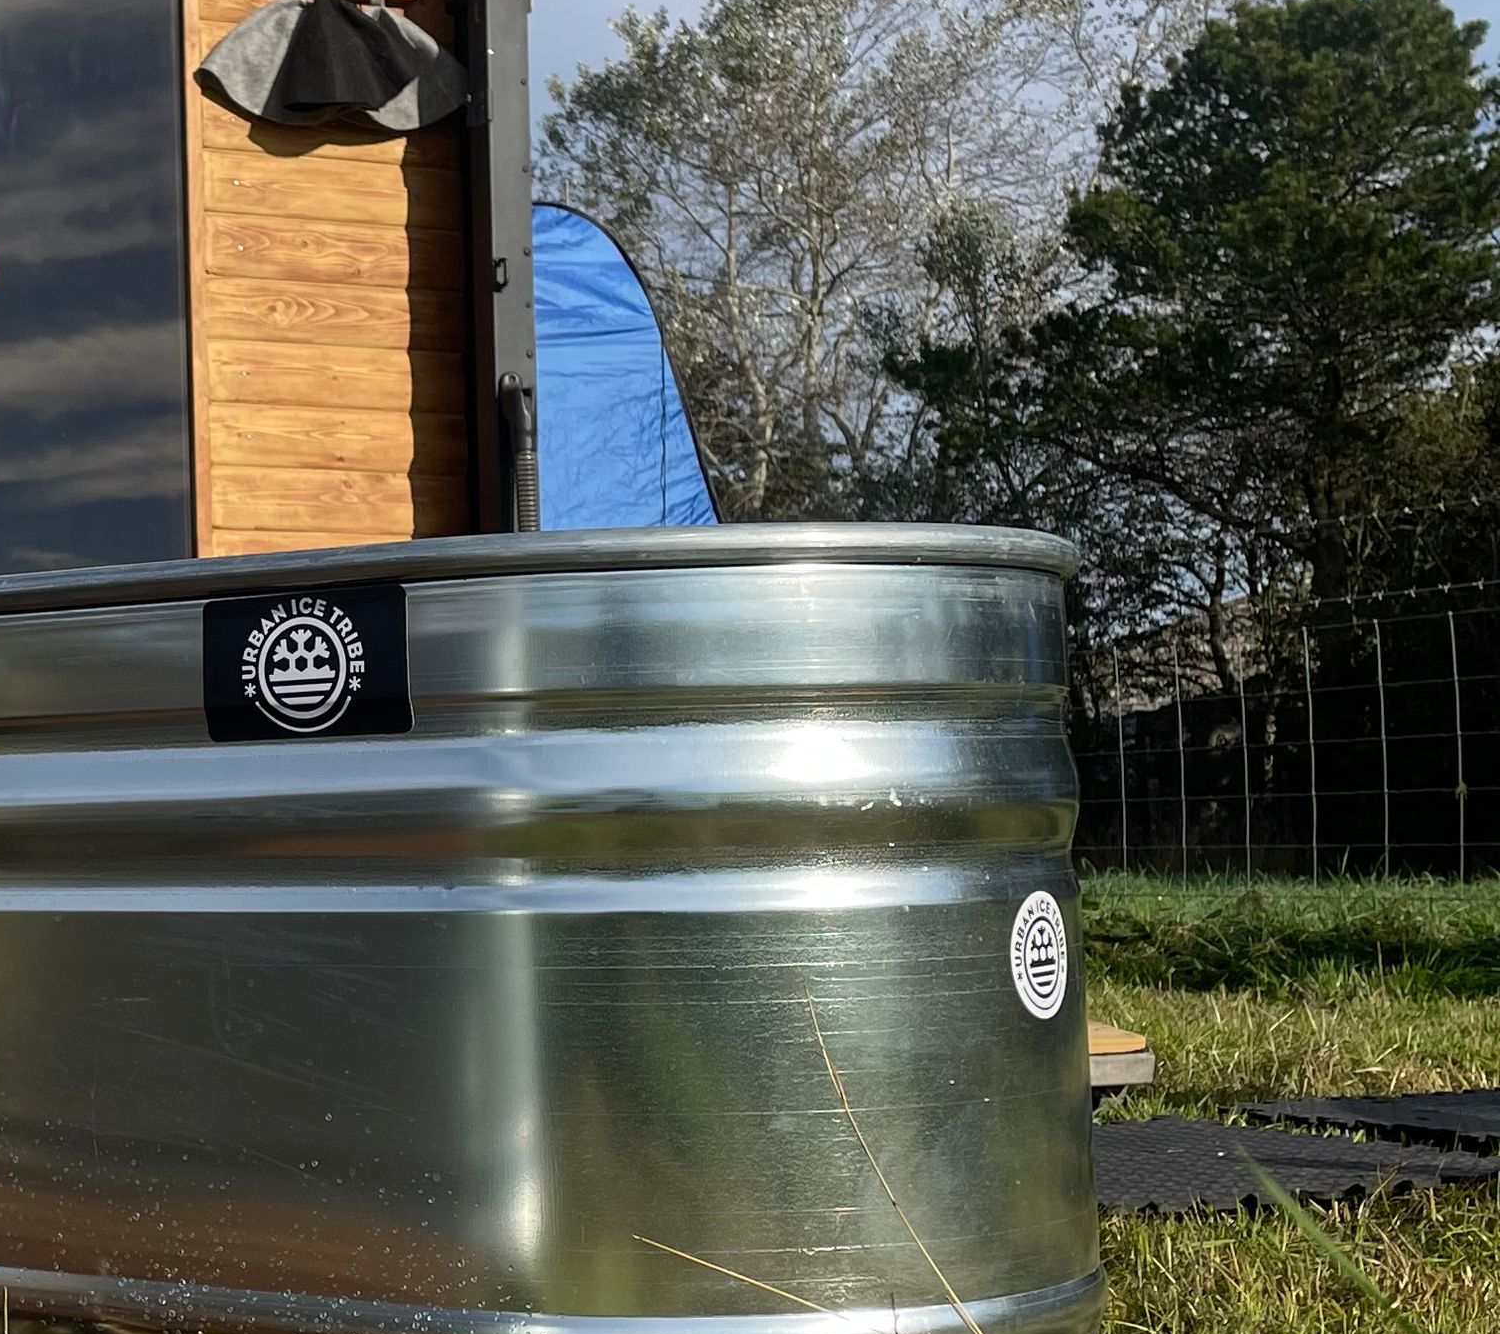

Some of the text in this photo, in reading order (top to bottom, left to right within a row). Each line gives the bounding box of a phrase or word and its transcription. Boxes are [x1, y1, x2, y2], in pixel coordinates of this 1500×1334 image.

[241, 597, 365, 680] URBAN ICE TRIBE
[1015, 906, 1035, 967] URBAN
[1036, 899, 1051, 915] ICE
